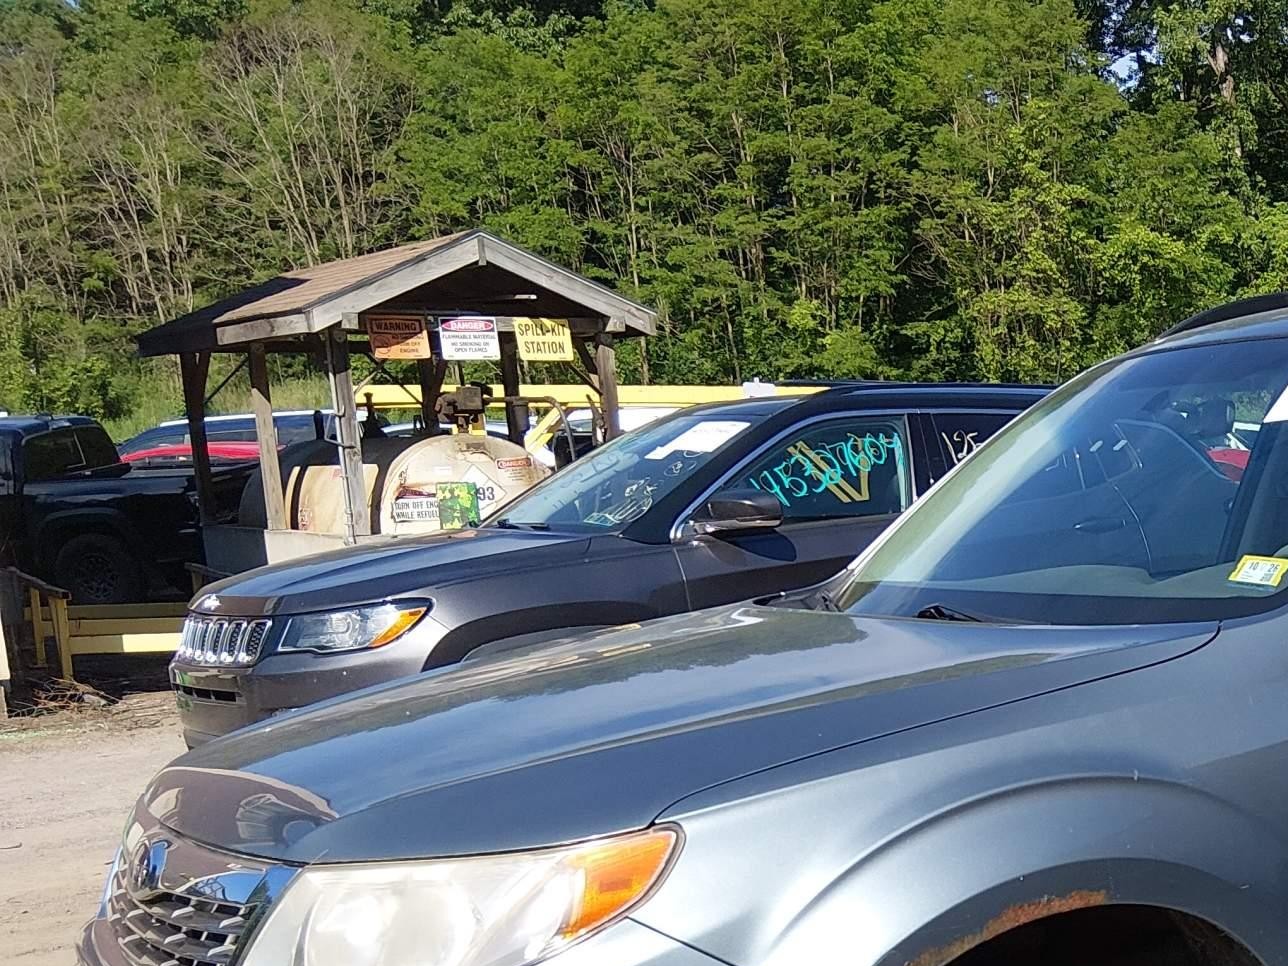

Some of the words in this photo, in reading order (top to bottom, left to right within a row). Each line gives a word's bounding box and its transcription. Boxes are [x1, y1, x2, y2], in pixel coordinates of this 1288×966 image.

[375, 321, 417, 331] WARNING
[450, 321, 485, 331] DANGER
[517, 323, 566, 336] SPILL-KIT
[524, 340, 566, 354] STATION
[396, 511, 415, 519] WHILE
